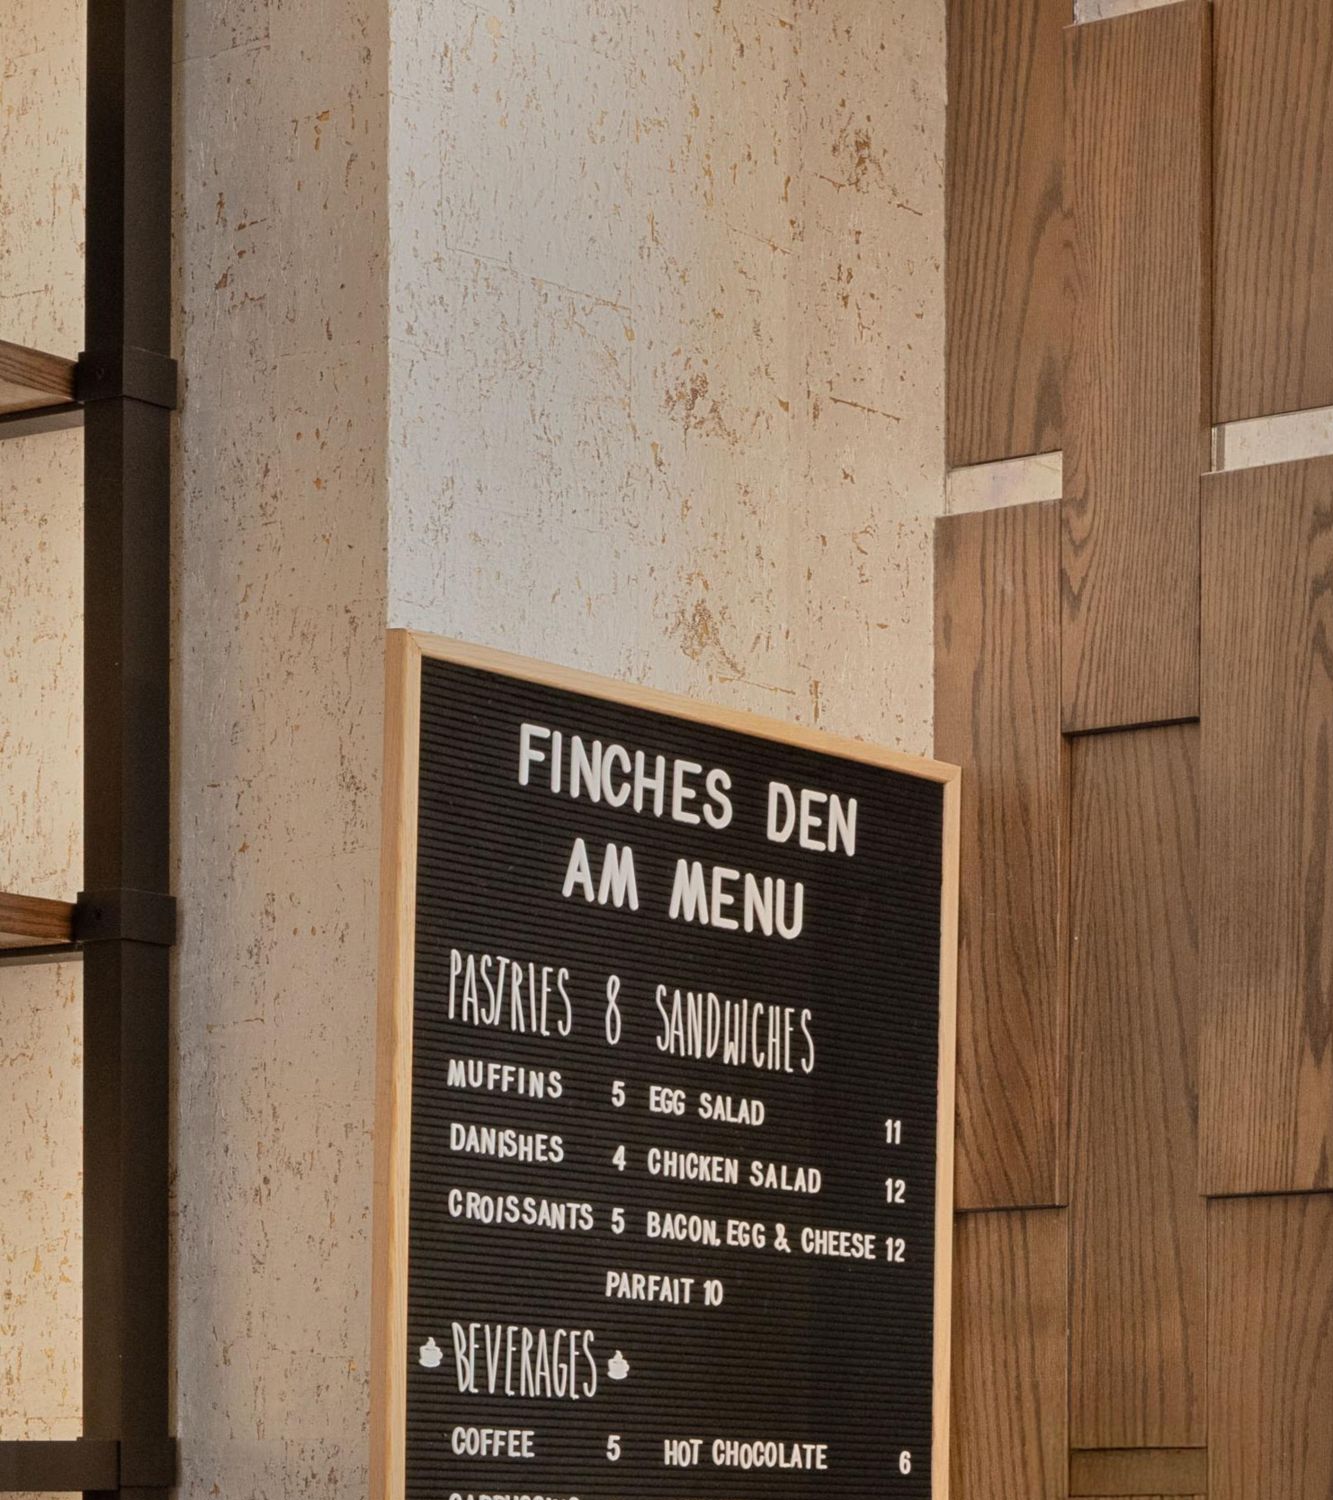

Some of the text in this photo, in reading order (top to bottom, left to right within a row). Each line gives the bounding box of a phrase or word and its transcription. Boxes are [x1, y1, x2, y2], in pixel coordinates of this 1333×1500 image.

[518, 722, 858, 857] FINCHES DEN
[561, 837, 804, 940] AM MENU
[448, 948, 572, 1037] PASTRIES
[655, 983, 815, 1074] SANDWICHES
[446, 1058, 626, 1108] MUFFINS 5
[649, 1085, 902, 1145] EGG SALAD 11
[449, 1122, 627, 1172] DANISHES 4
[647, 1147, 906, 1204] CHICKEN SALAD 12
[448, 1188, 626, 1235] CROISSANTS 5
[726, 1223, 765, 1249] EGG
[773, 1222, 792, 1254] &
[800, 1226, 877, 1260] CHEESE
[885, 1236, 906, 1263] 12
[605, 1270, 724, 1307] PARFAIT 10
[451, 1321, 598, 1401] BEVERAGES
[451, 1426, 621, 1462] COFFEE 5
[663, 1438, 912, 1475] HOT CHOCOLATE 6
